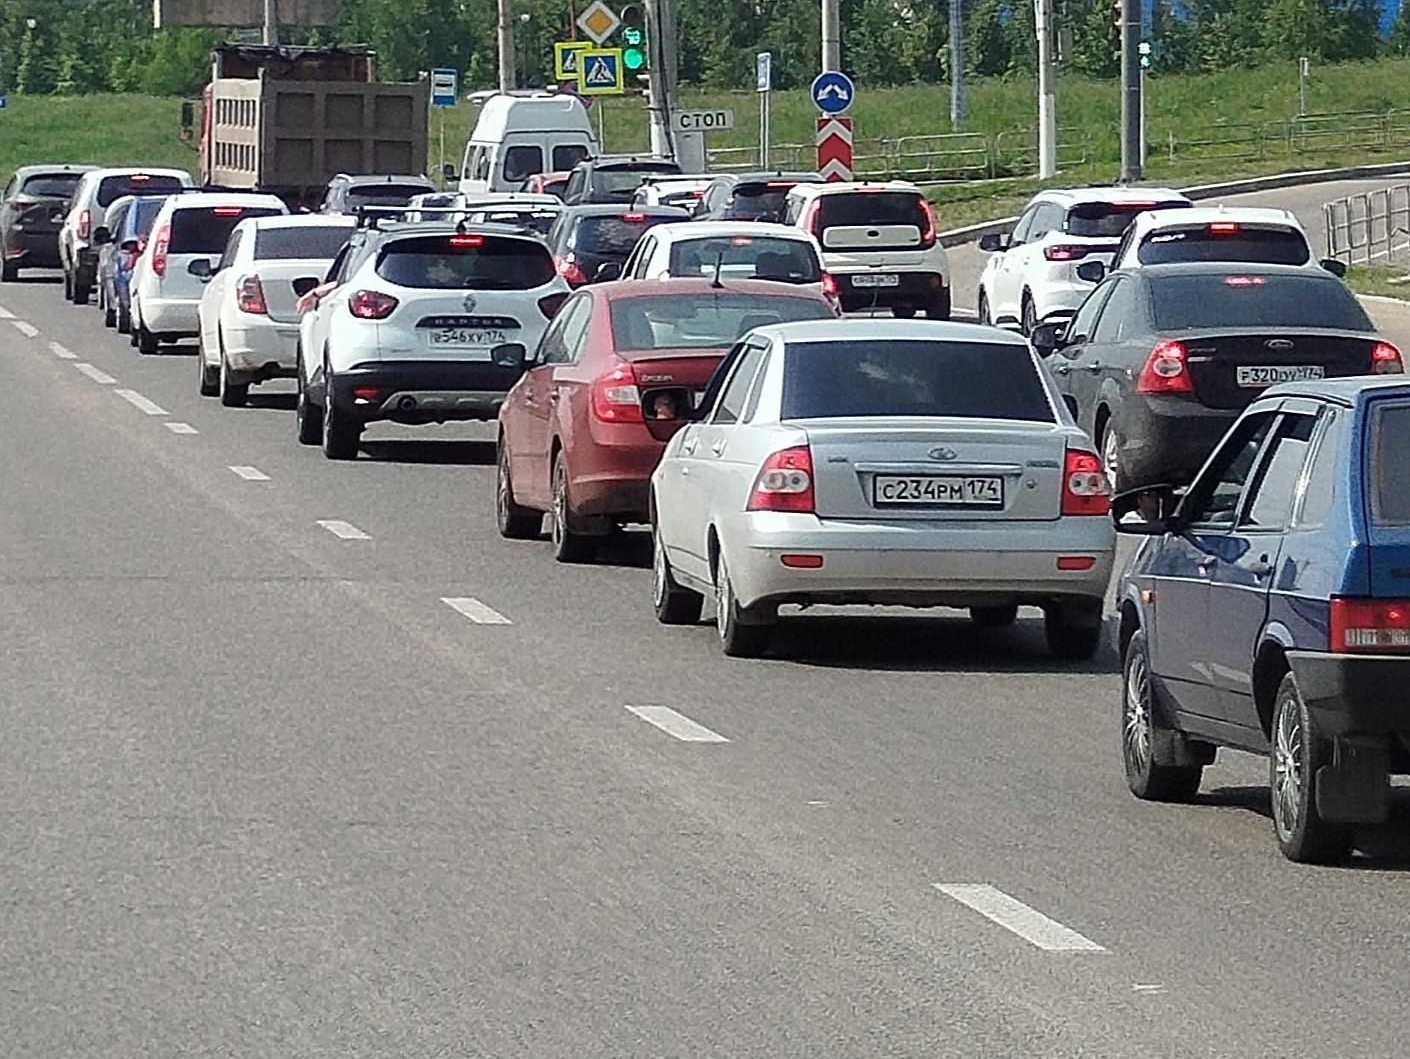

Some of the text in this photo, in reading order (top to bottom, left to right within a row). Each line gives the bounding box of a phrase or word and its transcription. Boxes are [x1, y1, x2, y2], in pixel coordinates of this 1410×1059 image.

[680, 112, 726, 128] СТОП
[883, 480, 997, 499] С234РМ 174
